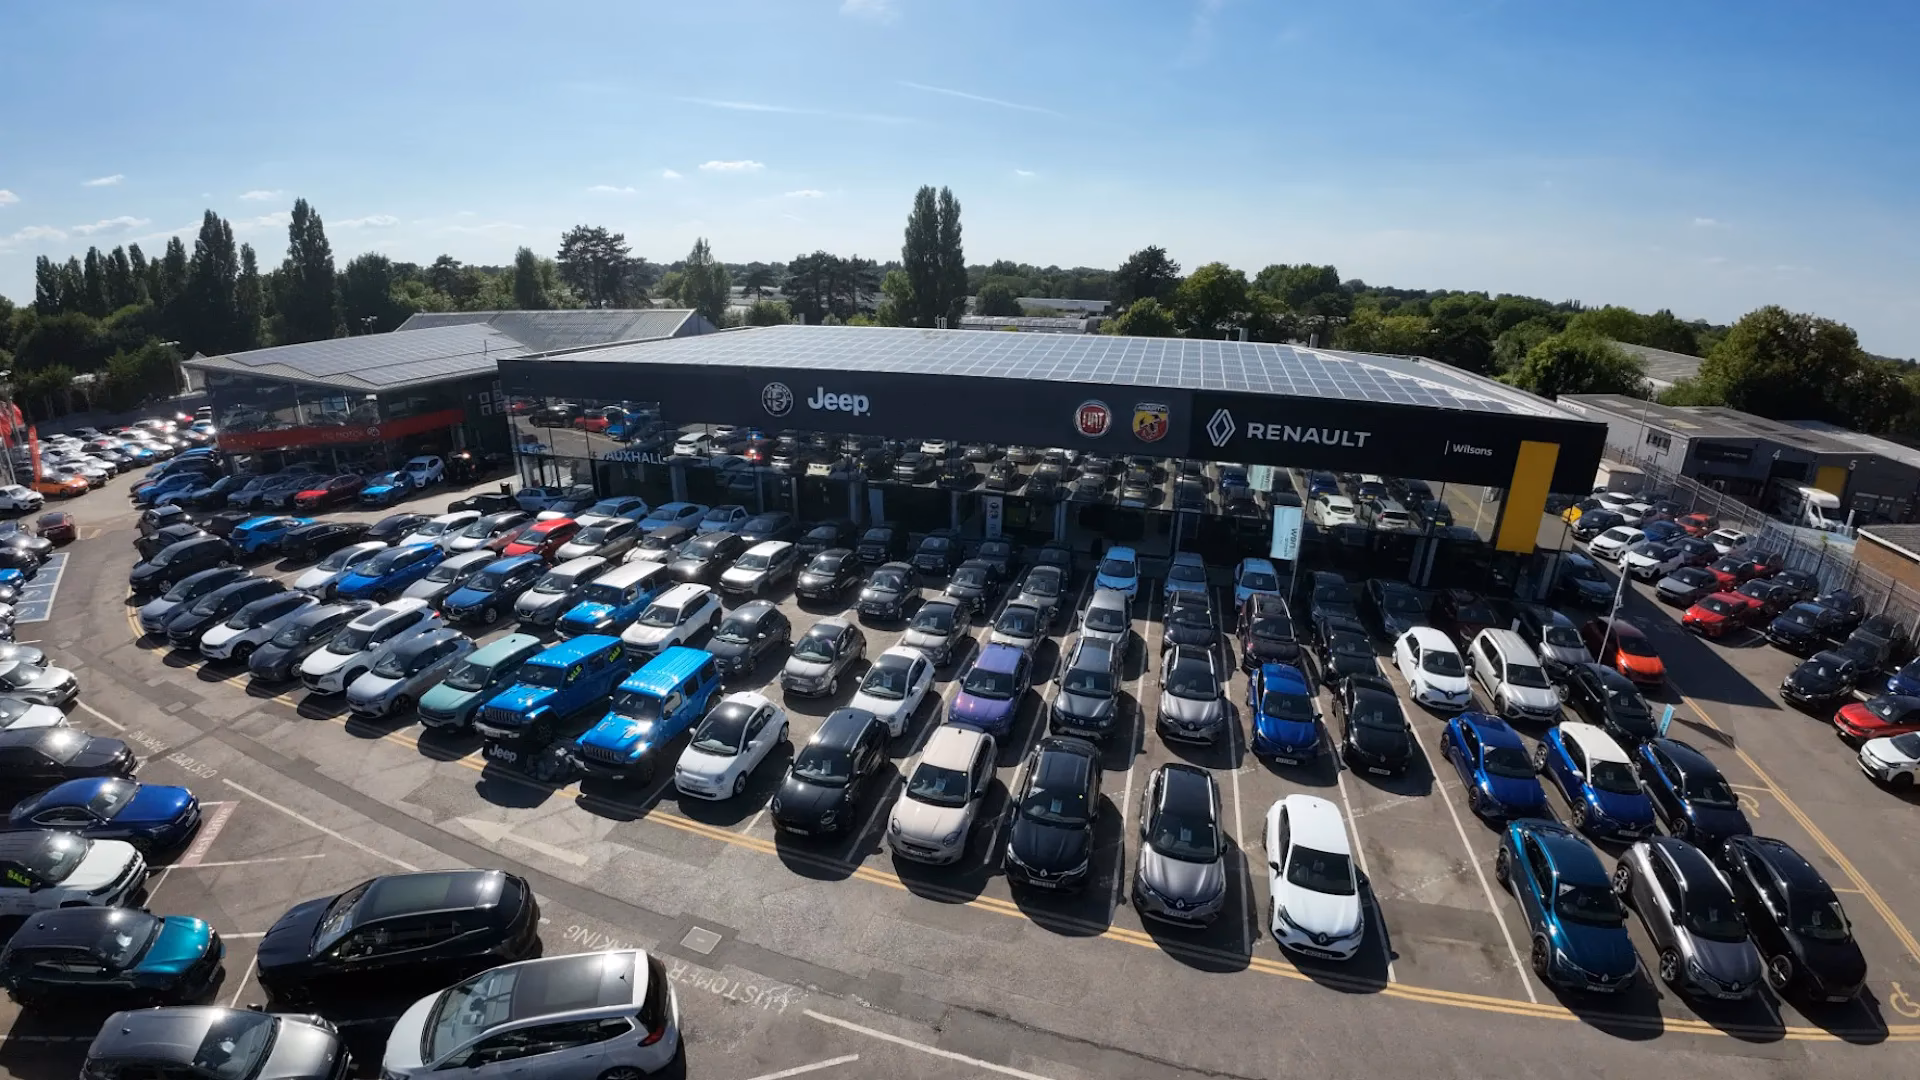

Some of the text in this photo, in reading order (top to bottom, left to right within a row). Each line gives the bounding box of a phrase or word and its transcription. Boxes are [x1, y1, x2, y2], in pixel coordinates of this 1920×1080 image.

[808, 387, 870, 416] Jeep
[1082, 412, 1105, 428] FIAT
[1246, 422, 1371, 447] RENAULT
[1453, 444, 1493, 456] Wilsons
[1772, 449, 1781, 460] 4
[1848, 460, 1858, 470] 5
[489, 744, 517, 763] Jeep
[7, 869, 31, 886] SALE
